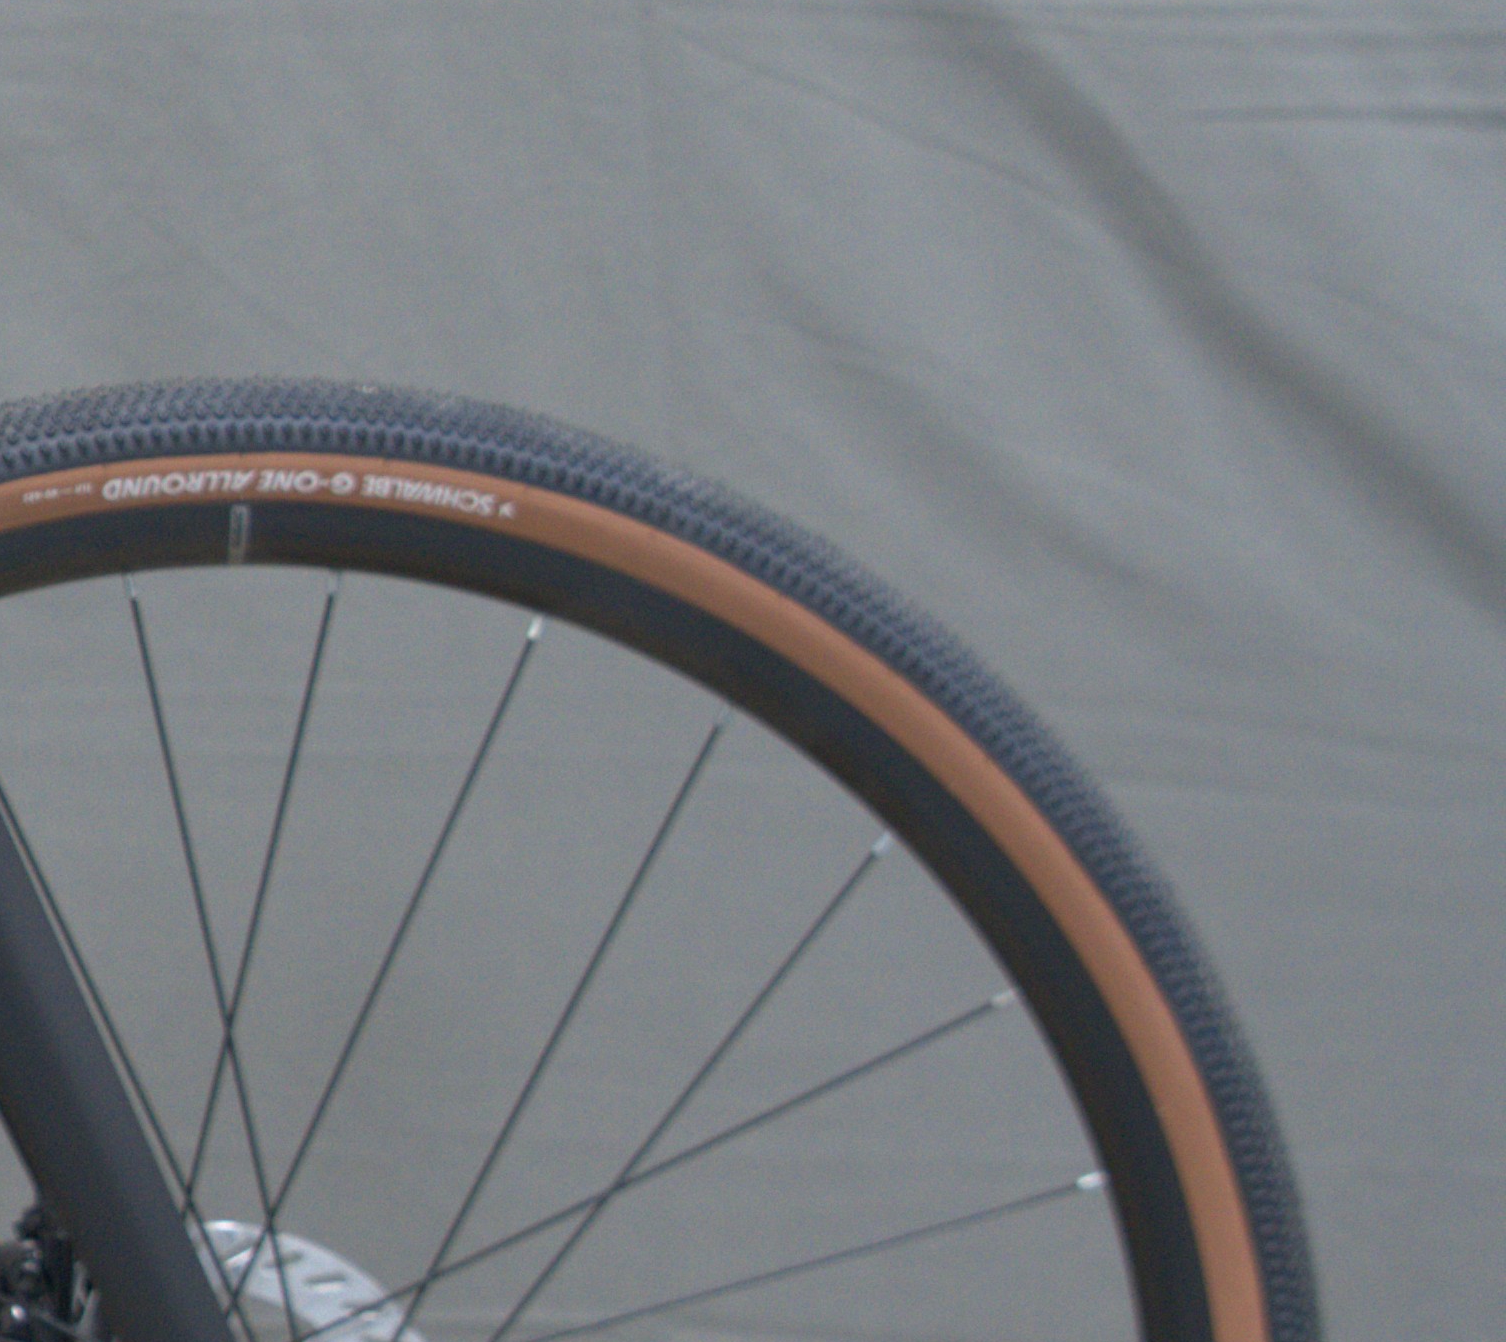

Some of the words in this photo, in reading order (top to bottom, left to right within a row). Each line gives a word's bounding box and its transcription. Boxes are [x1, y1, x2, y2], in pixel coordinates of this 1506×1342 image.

[102, 469, 255, 502] ALLROUND
[257, 469, 356, 495] G-ONE
[362, 475, 500, 518] SCHWALBE
